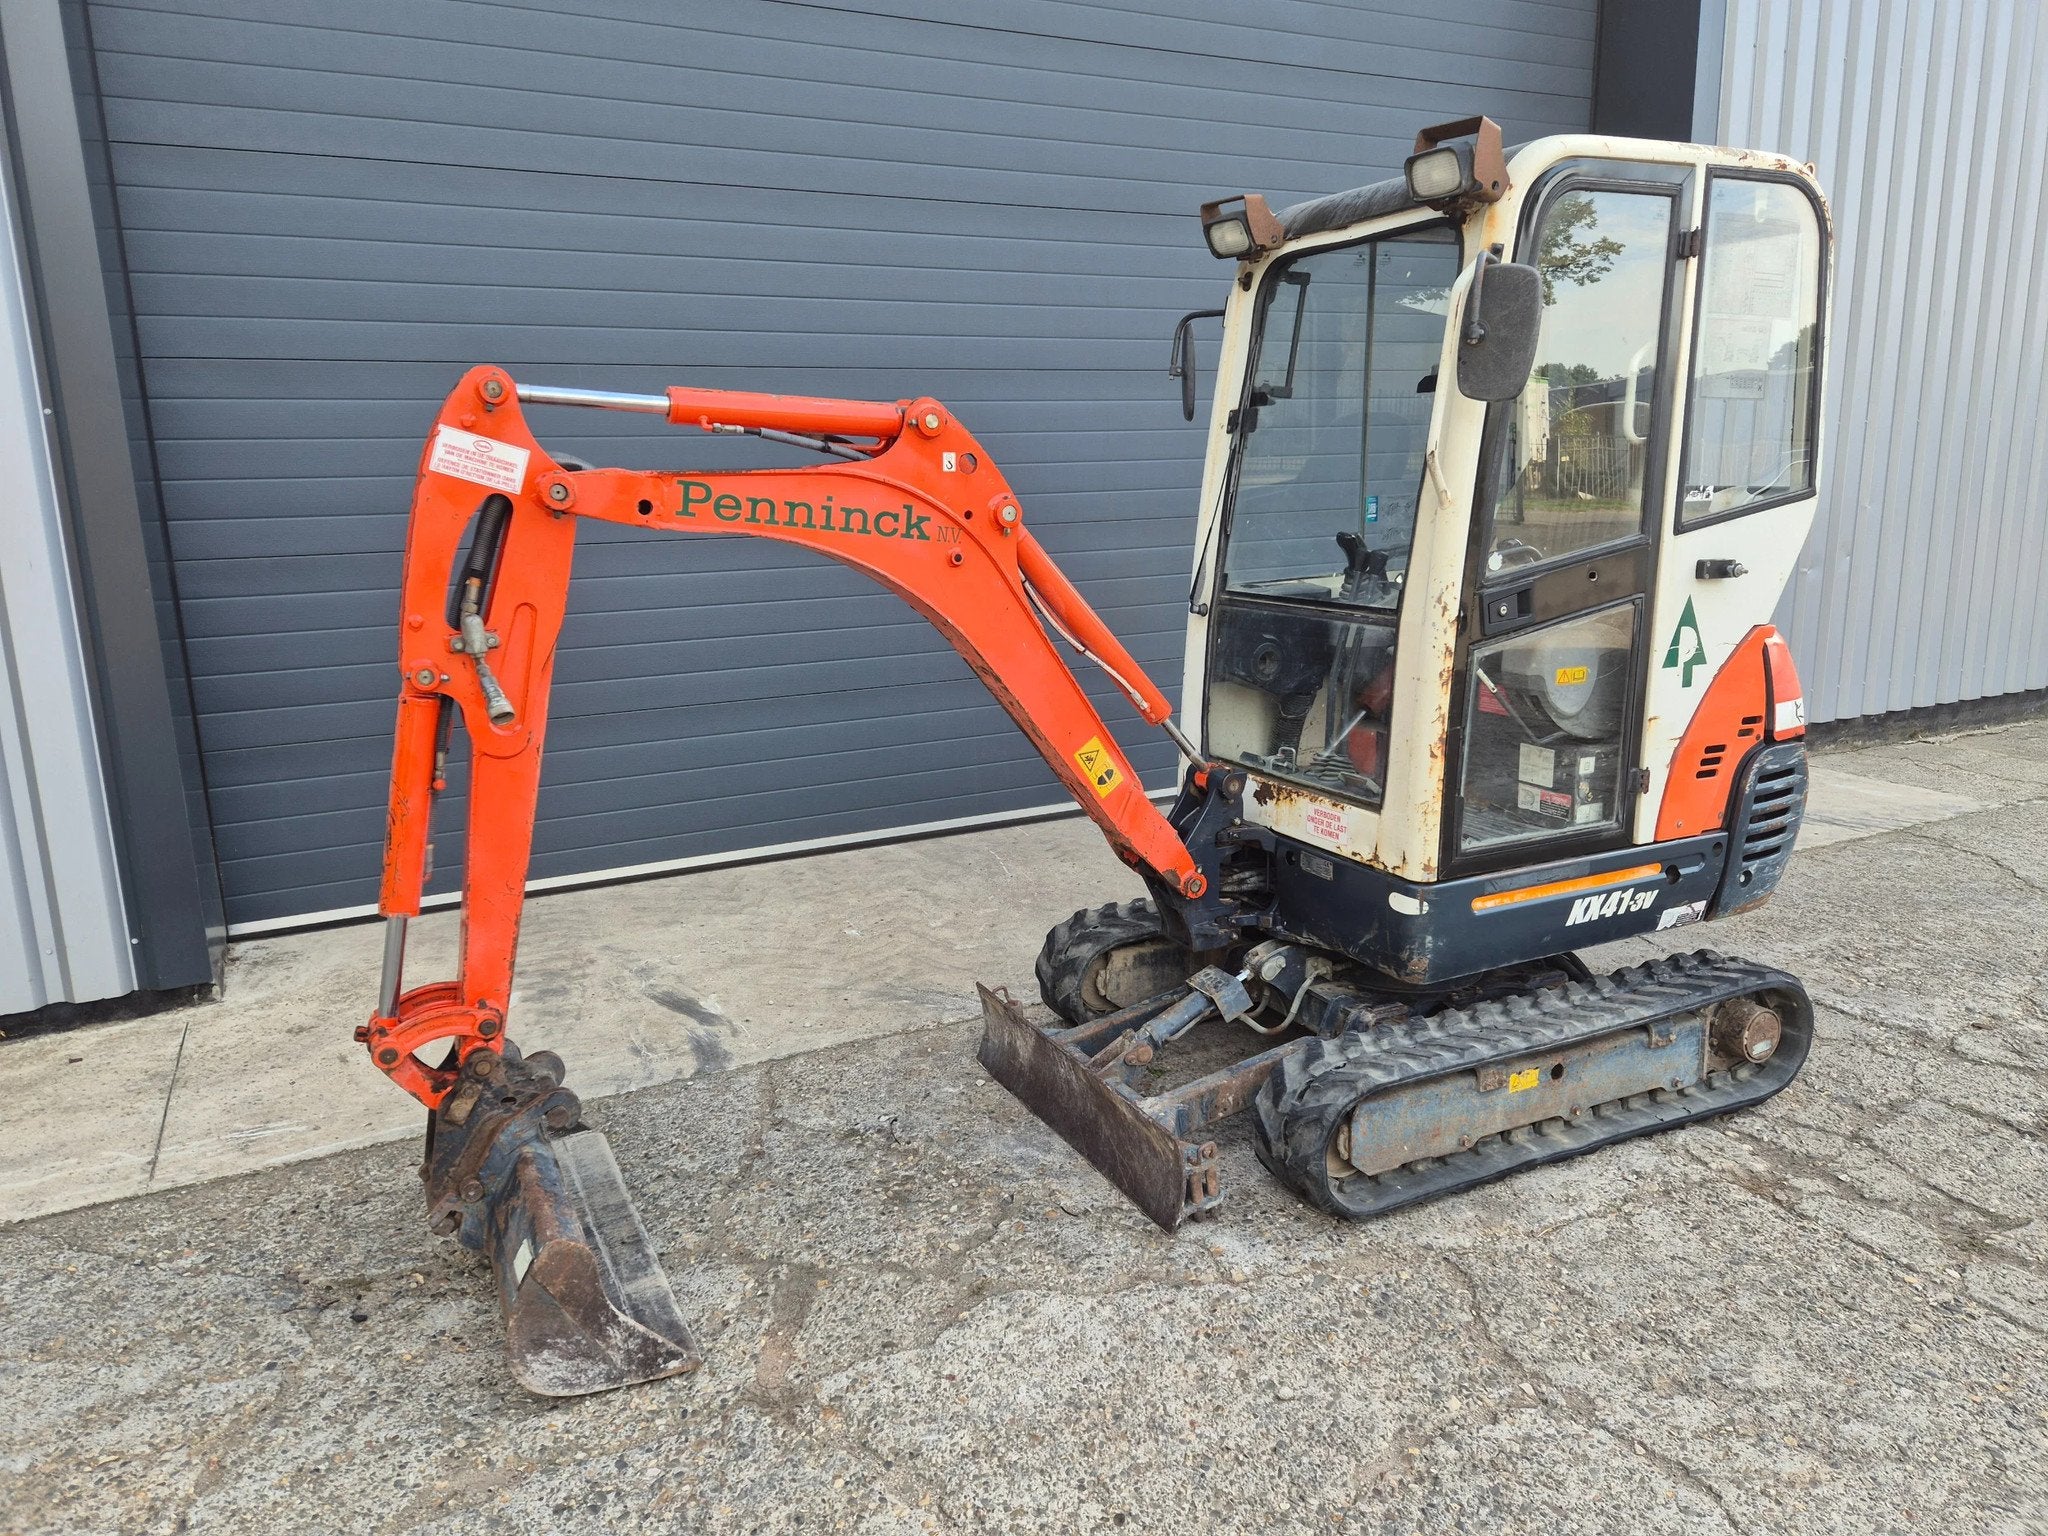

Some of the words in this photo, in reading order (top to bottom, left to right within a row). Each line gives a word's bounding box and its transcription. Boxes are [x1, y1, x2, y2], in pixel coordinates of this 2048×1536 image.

[675, 479, 931, 541] Penninck
[1307, 815, 1324, 826] ONDER
[1325, 820, 1332, 829] DE
[1333, 823, 1347, 834] LAST
[1314, 808, 1341, 822] VERBODEN
[1314, 826, 1319, 834] TE
[1320, 828, 1339, 840] KOMEN
[1565, 888, 1659, 926] KX41-3V
